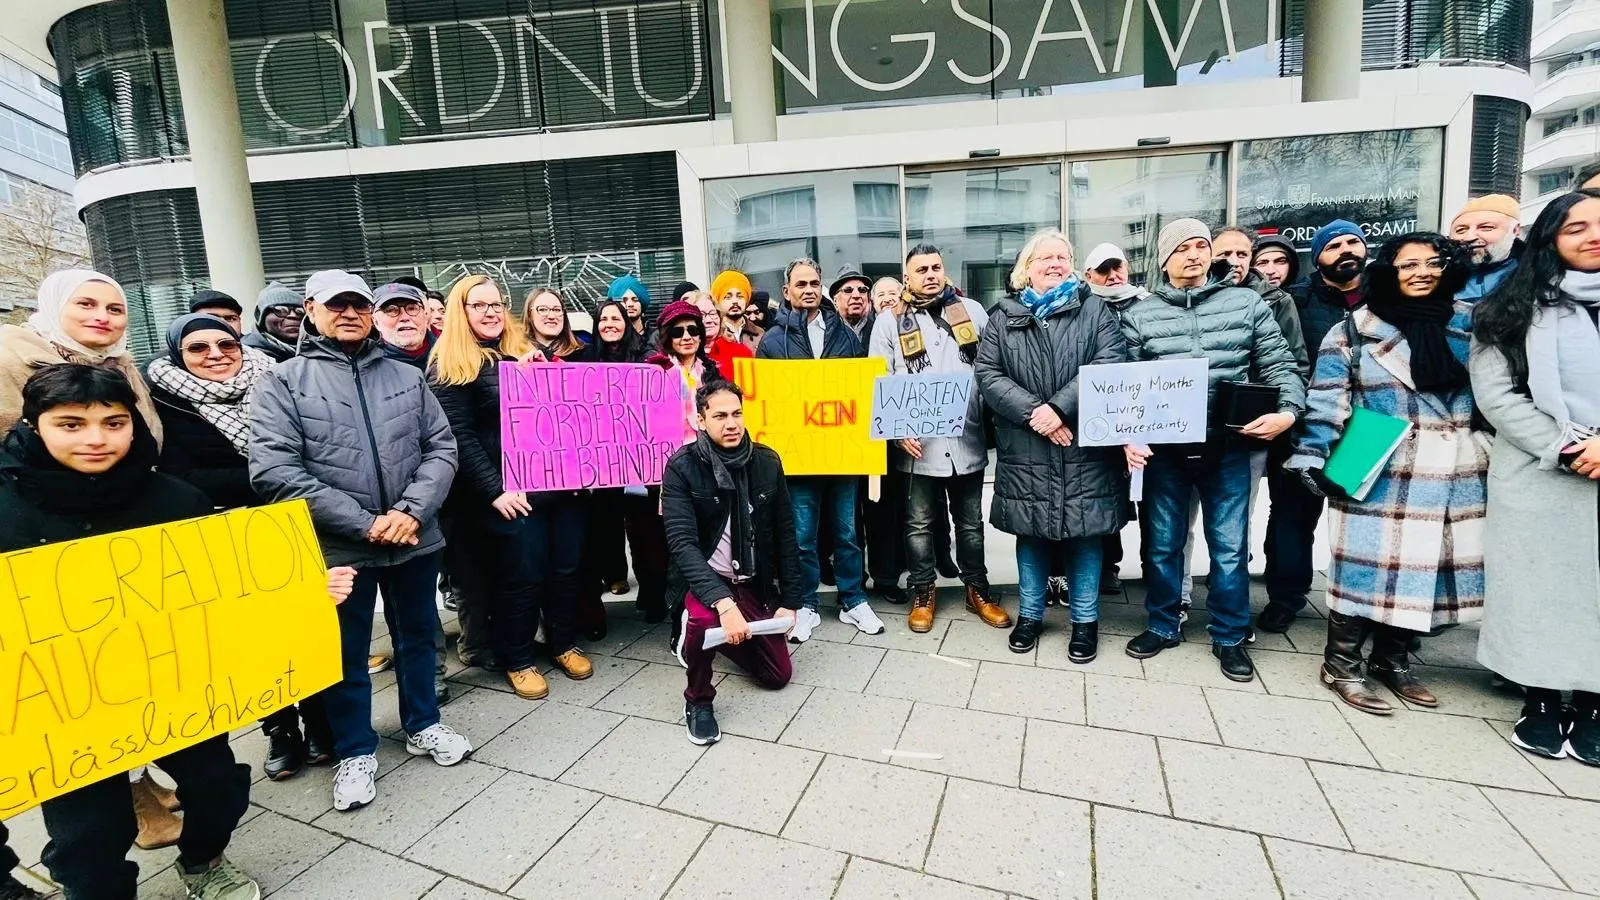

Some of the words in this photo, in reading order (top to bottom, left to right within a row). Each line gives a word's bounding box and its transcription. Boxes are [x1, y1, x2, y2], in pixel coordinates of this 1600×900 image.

[1281, 219, 1418, 242] ORDGSAMT
[505, 366, 683, 405] INTEGRATION
[879, 379, 970, 410] WARTEN
[1091, 380, 1141, 400] Waiting
[1149, 375, 1195, 391] Months
[761, 399, 789, 427] IST
[803, 399, 857, 428] KEIN
[909, 406, 943, 419] OHNE
[1106, 402, 1145, 419] Living
[1156, 401, 1169, 410] in
[893, 418, 946, 438] ENDE
[504, 448, 567, 489] NICHT
[0, 508, 327, 652] EGRATION
[0, 597, 218, 737] AUCHT
